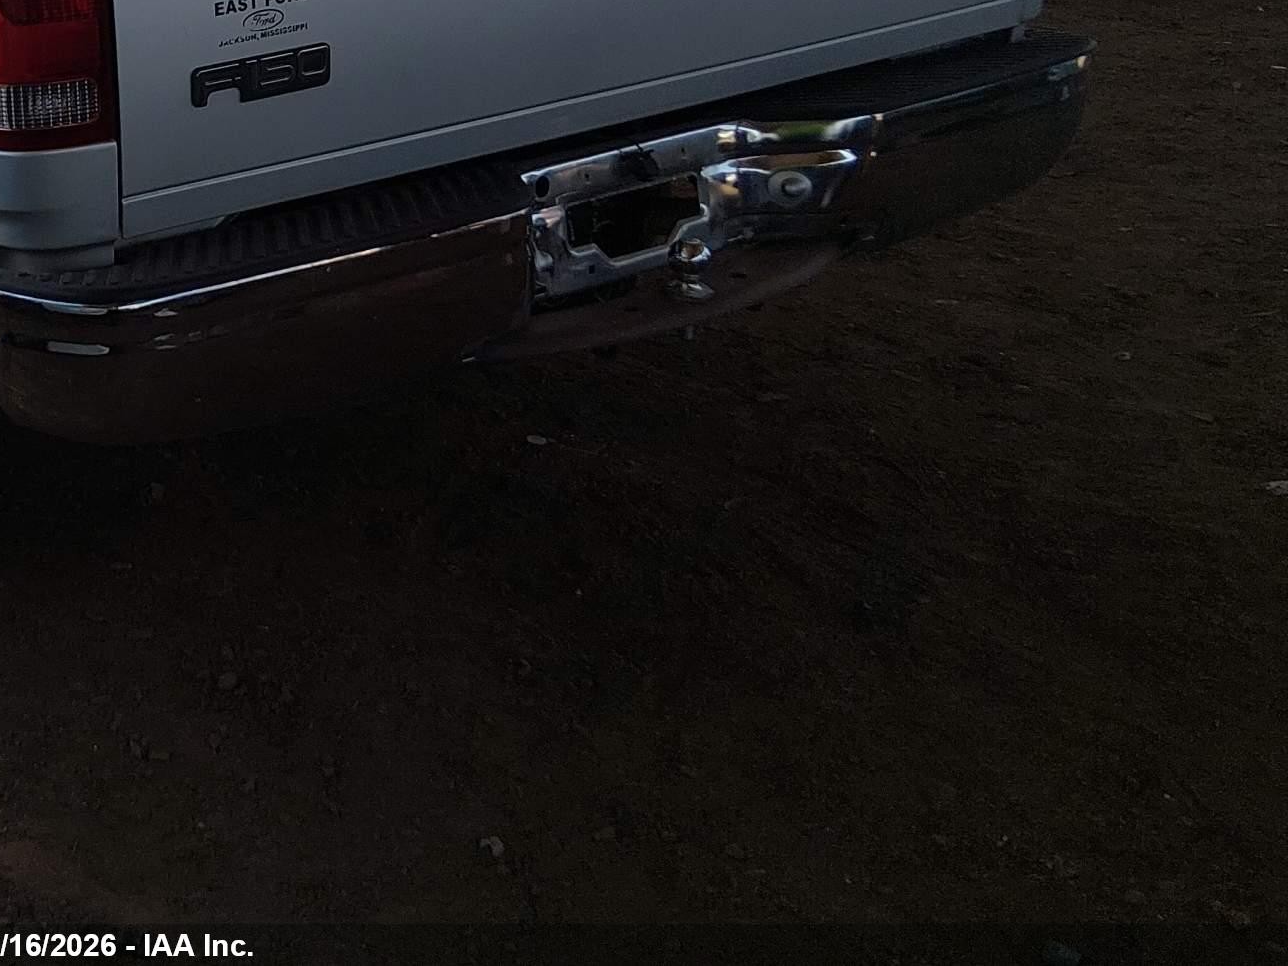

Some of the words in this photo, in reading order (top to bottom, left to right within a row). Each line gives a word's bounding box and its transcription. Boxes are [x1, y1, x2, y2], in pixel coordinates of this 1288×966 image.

[251, 12, 277, 27] Ford
[218, 33, 259, 48] JACKSON,
[260, 22, 309, 38] MISSISSIPPI
